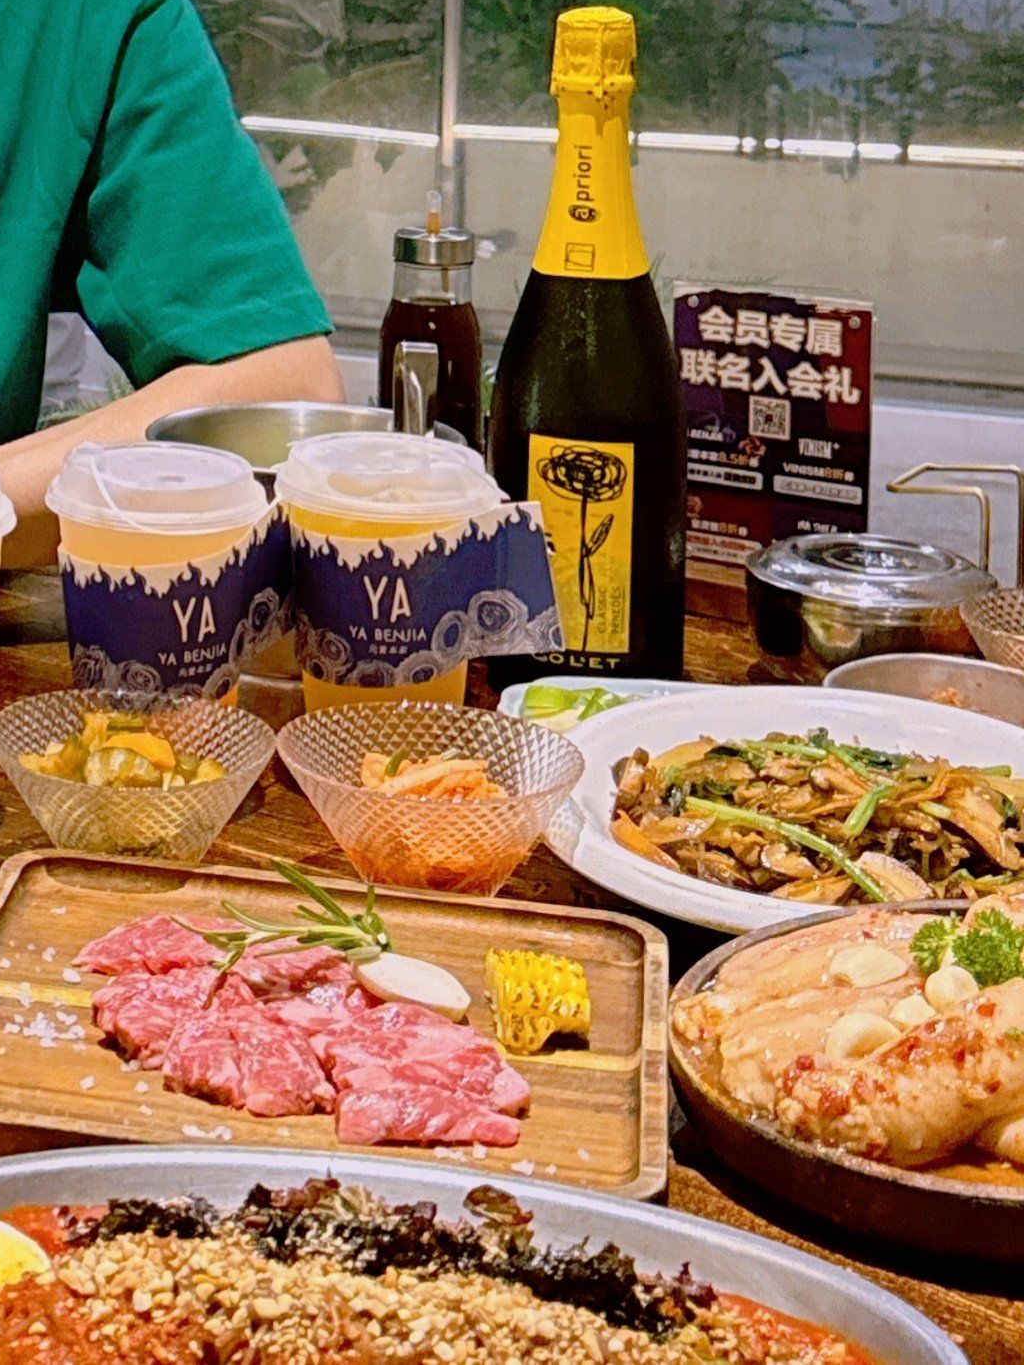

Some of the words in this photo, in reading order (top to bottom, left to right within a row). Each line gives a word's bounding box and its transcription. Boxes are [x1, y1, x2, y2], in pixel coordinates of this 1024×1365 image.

[697, 304, 843, 358] 会员专属
[679, 347, 862, 405] 联名入会礼
[172, 595, 216, 643] YA
[362, 575, 412, 624] YA
[157, 652, 178, 666] YA
[183, 642, 227, 664] BENJIA
[349, 625, 368, 641] YA
[374, 626, 427, 643] BENJIA
